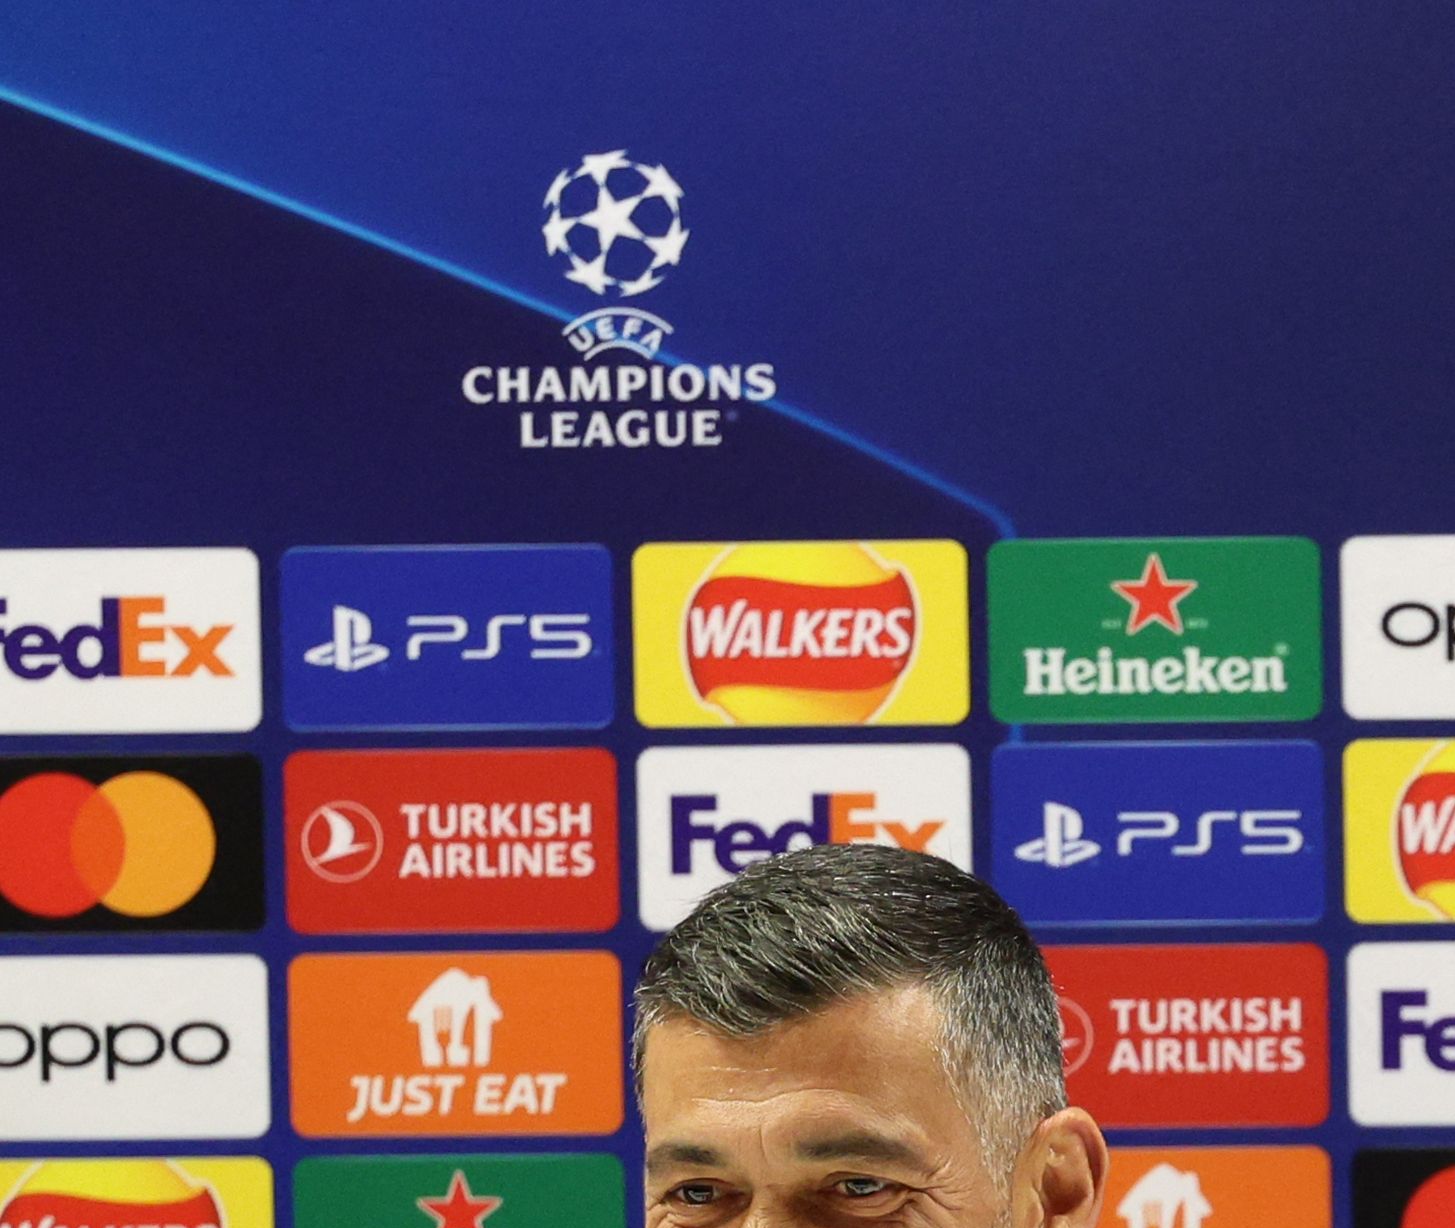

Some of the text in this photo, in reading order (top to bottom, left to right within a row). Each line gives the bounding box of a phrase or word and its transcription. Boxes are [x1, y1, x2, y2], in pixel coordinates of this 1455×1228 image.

[566, 312, 668, 352] UEFA
[462, 363, 776, 404] CHAMPIONS
[520, 409, 722, 448] LEAGUE
[0, 596, 233, 681] edEx
[407, 614, 592, 660] PS5
[689, 594, 912, 658] WALKERS
[1023, 646, 1287, 695] Heineken
[400, 802, 592, 839] TURKISH
[1117, 810, 1303, 856] PS5
[399, 841, 595, 878] AIRLINES
[1110, 997, 1302, 1034] TURKISH
[1108, 1036, 1305, 1073] AIRLINES
[347, 1073, 567, 1122] JUST EAT
